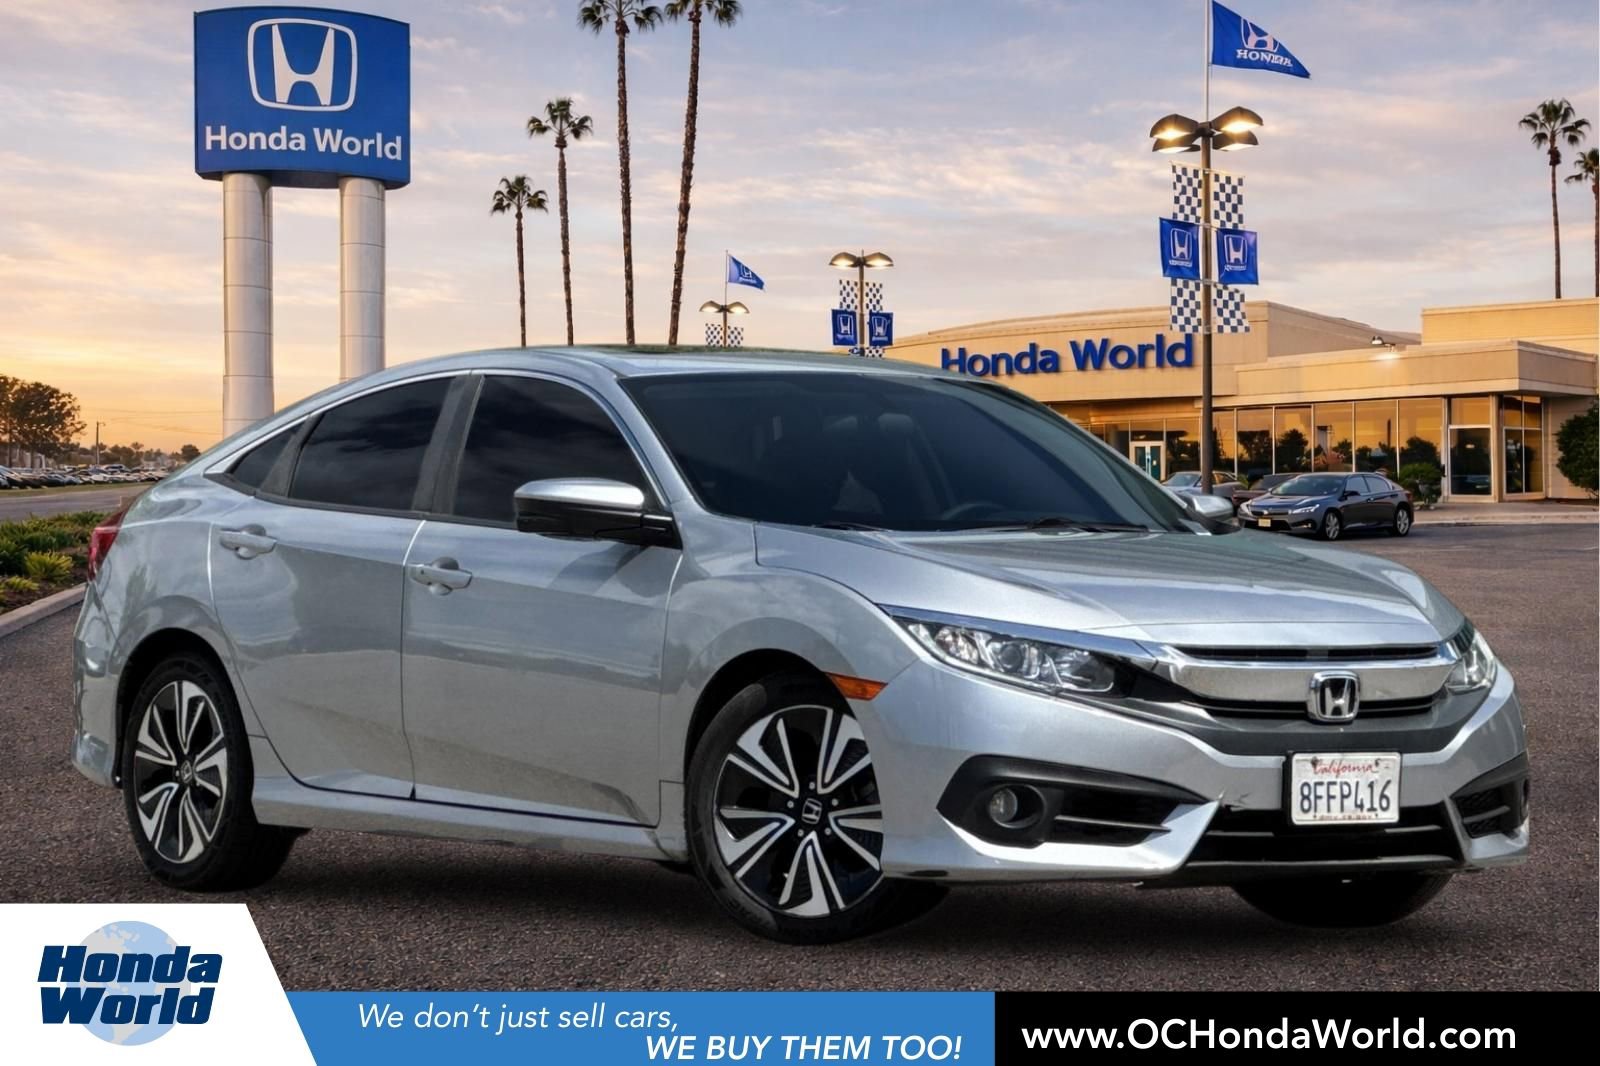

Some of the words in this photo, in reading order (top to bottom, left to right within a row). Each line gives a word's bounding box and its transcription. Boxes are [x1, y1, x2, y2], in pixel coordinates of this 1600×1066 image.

[205, 125, 306, 151] Honda
[313, 127, 402, 160] World
[941, 343, 1060, 377] Honda
[1069, 333, 1193, 370] World
[1313, 760, 1373, 778] California
[1300, 780, 1392, 813] 8FFP416
